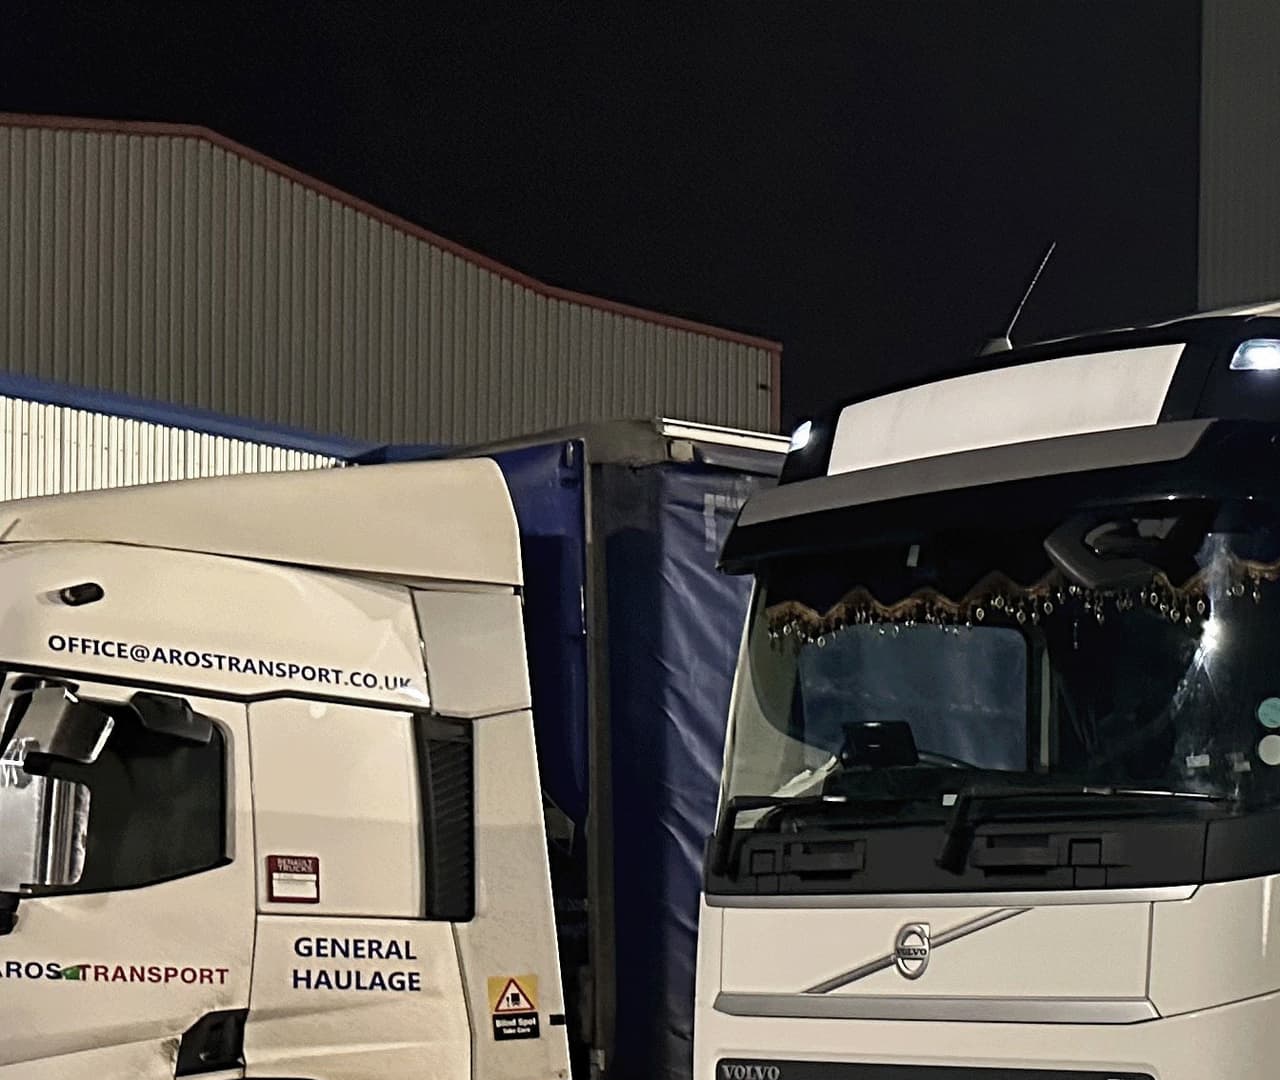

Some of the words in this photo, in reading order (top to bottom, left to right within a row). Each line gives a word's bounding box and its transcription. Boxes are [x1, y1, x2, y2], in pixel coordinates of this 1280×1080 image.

[47, 635, 411, 691] OFFICE@AROSTRANSPORT.CO.UK
[277, 864, 313, 872] TRUCKS
[294, 937, 417, 960] GENERAL
[0, 961, 63, 980] ROS
[78, 963, 229, 985] TRANSPORT
[292, 969, 421, 992] HAULAGE
[721, 1064, 780, 1080] VOLVO
